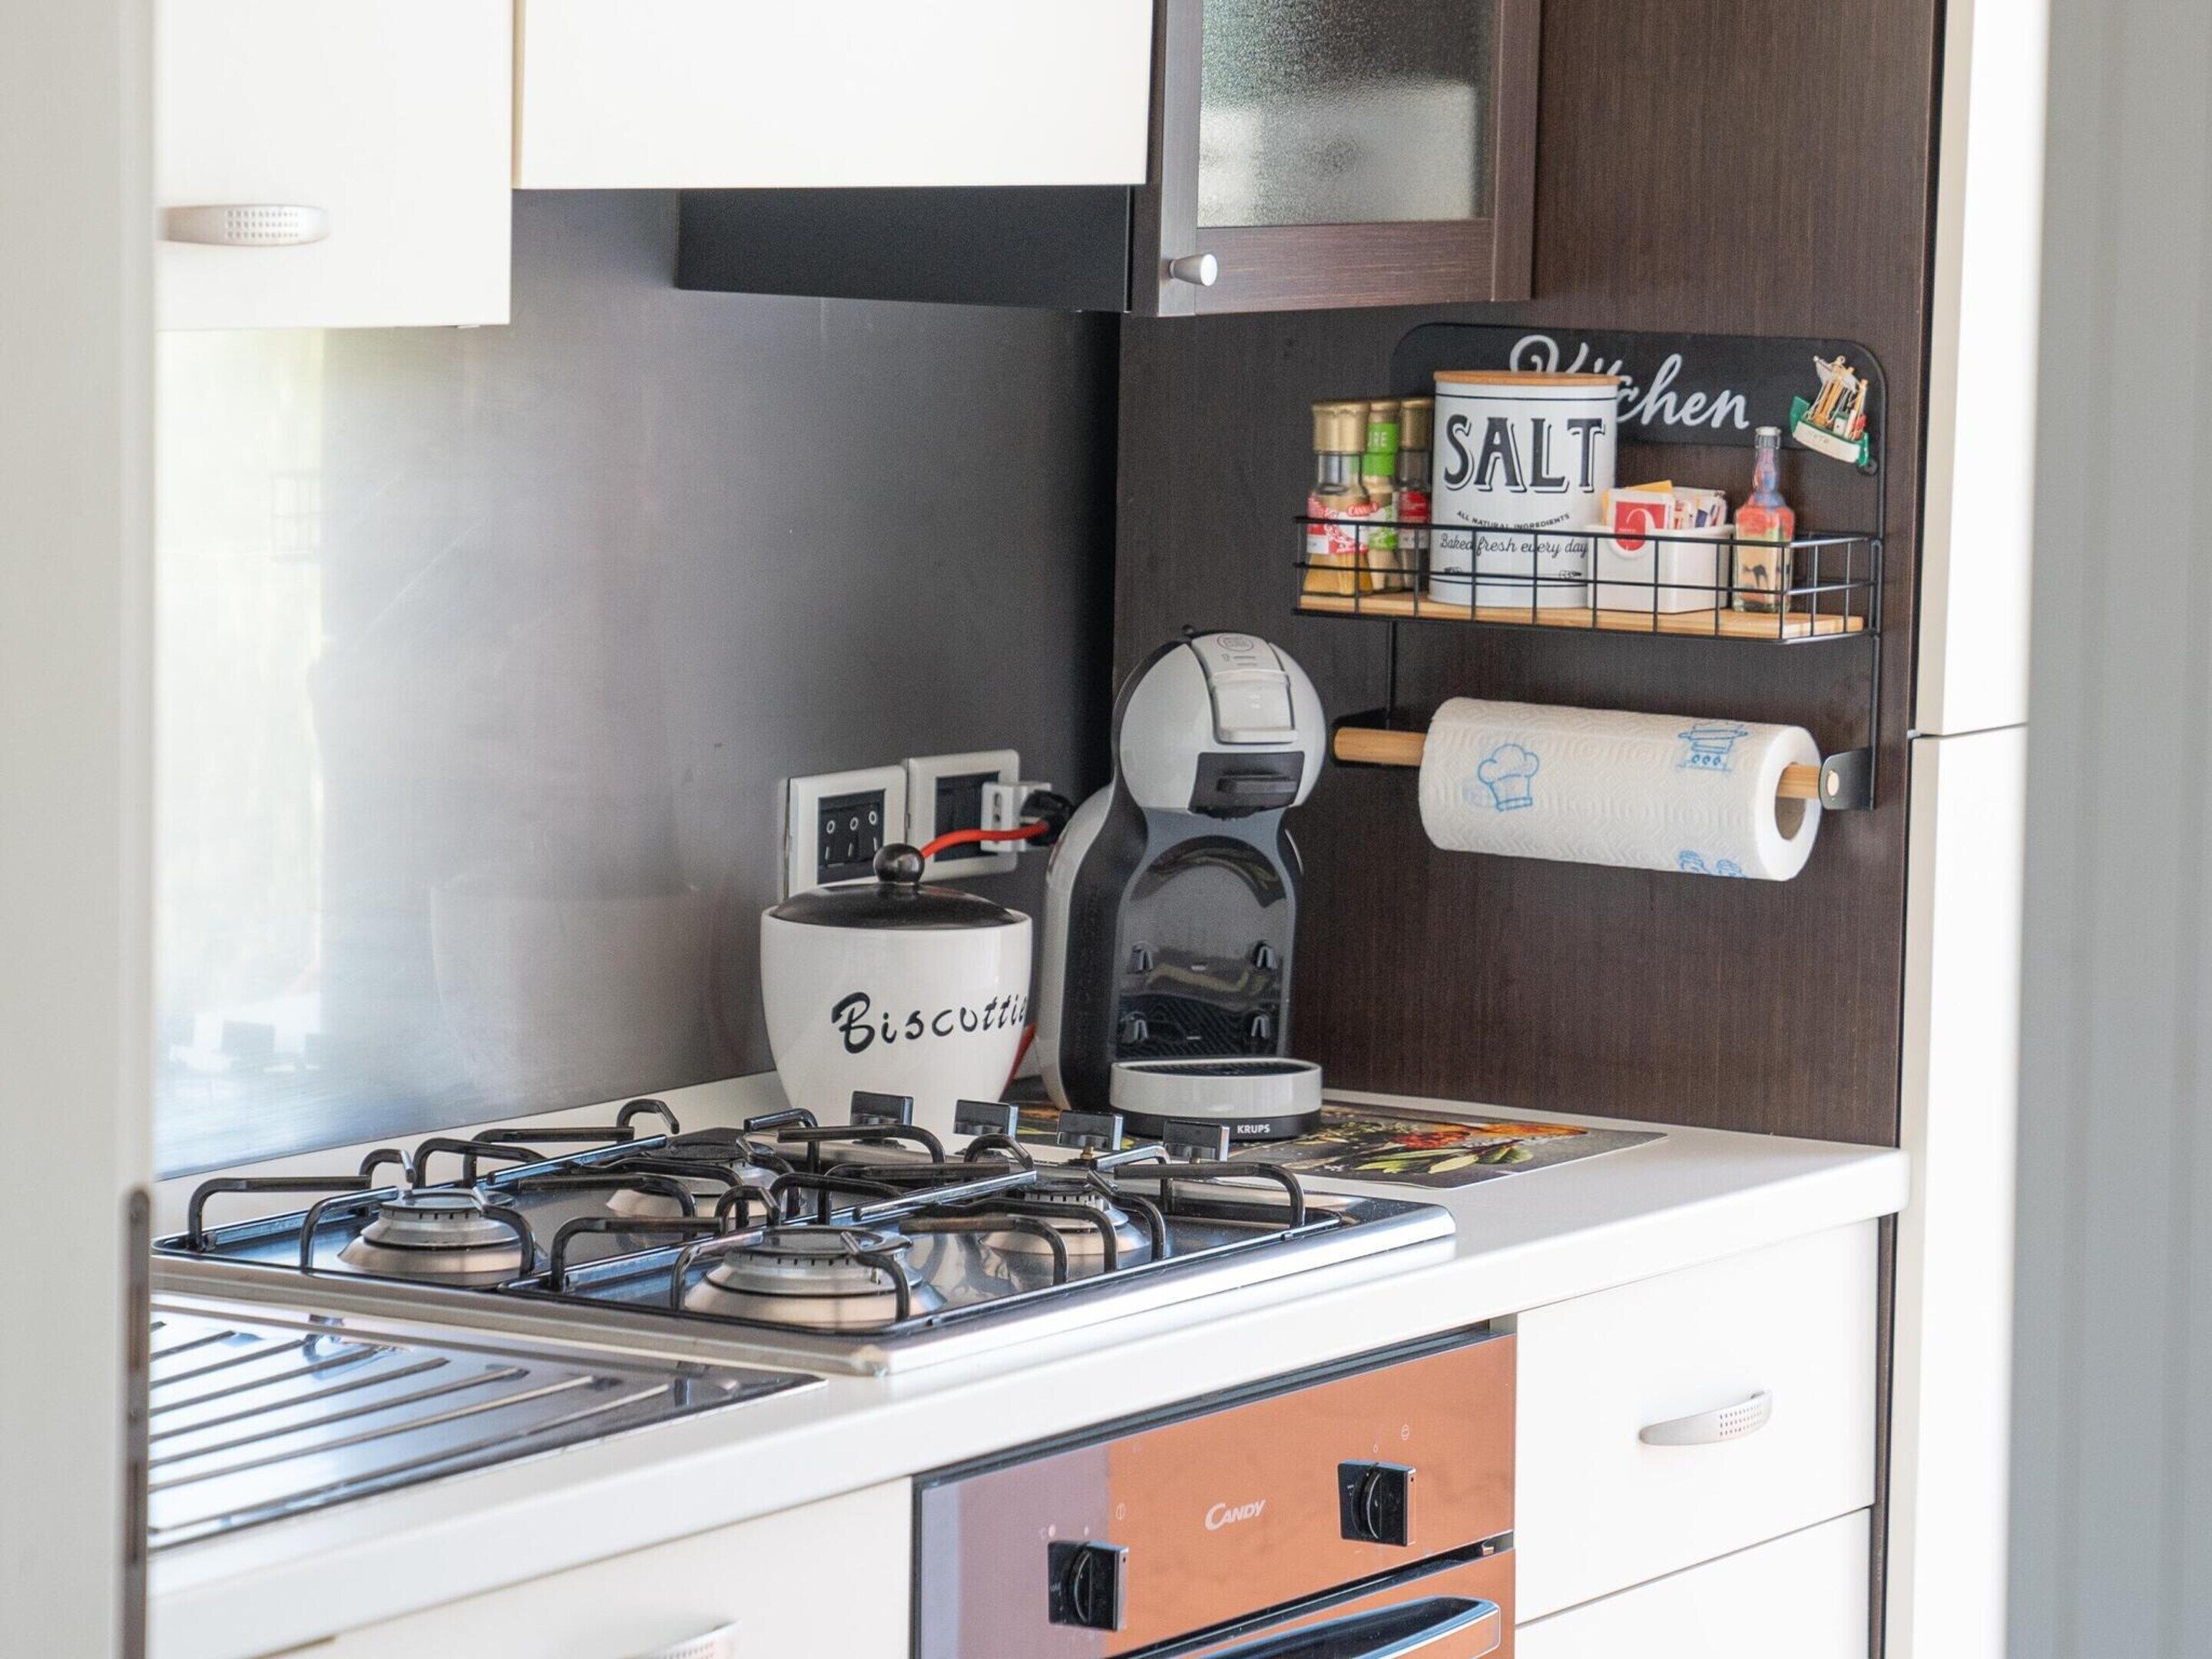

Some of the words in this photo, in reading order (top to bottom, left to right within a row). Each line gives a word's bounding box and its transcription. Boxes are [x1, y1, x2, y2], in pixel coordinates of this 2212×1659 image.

[1444, 414, 1606, 493] SALT
[1456, 510, 1470, 522] ALL
[1475, 535, 1517, 557] fresh
[1565, 538, 1588, 559] day
[1237, 1124, 1270, 1134] KRUPS
